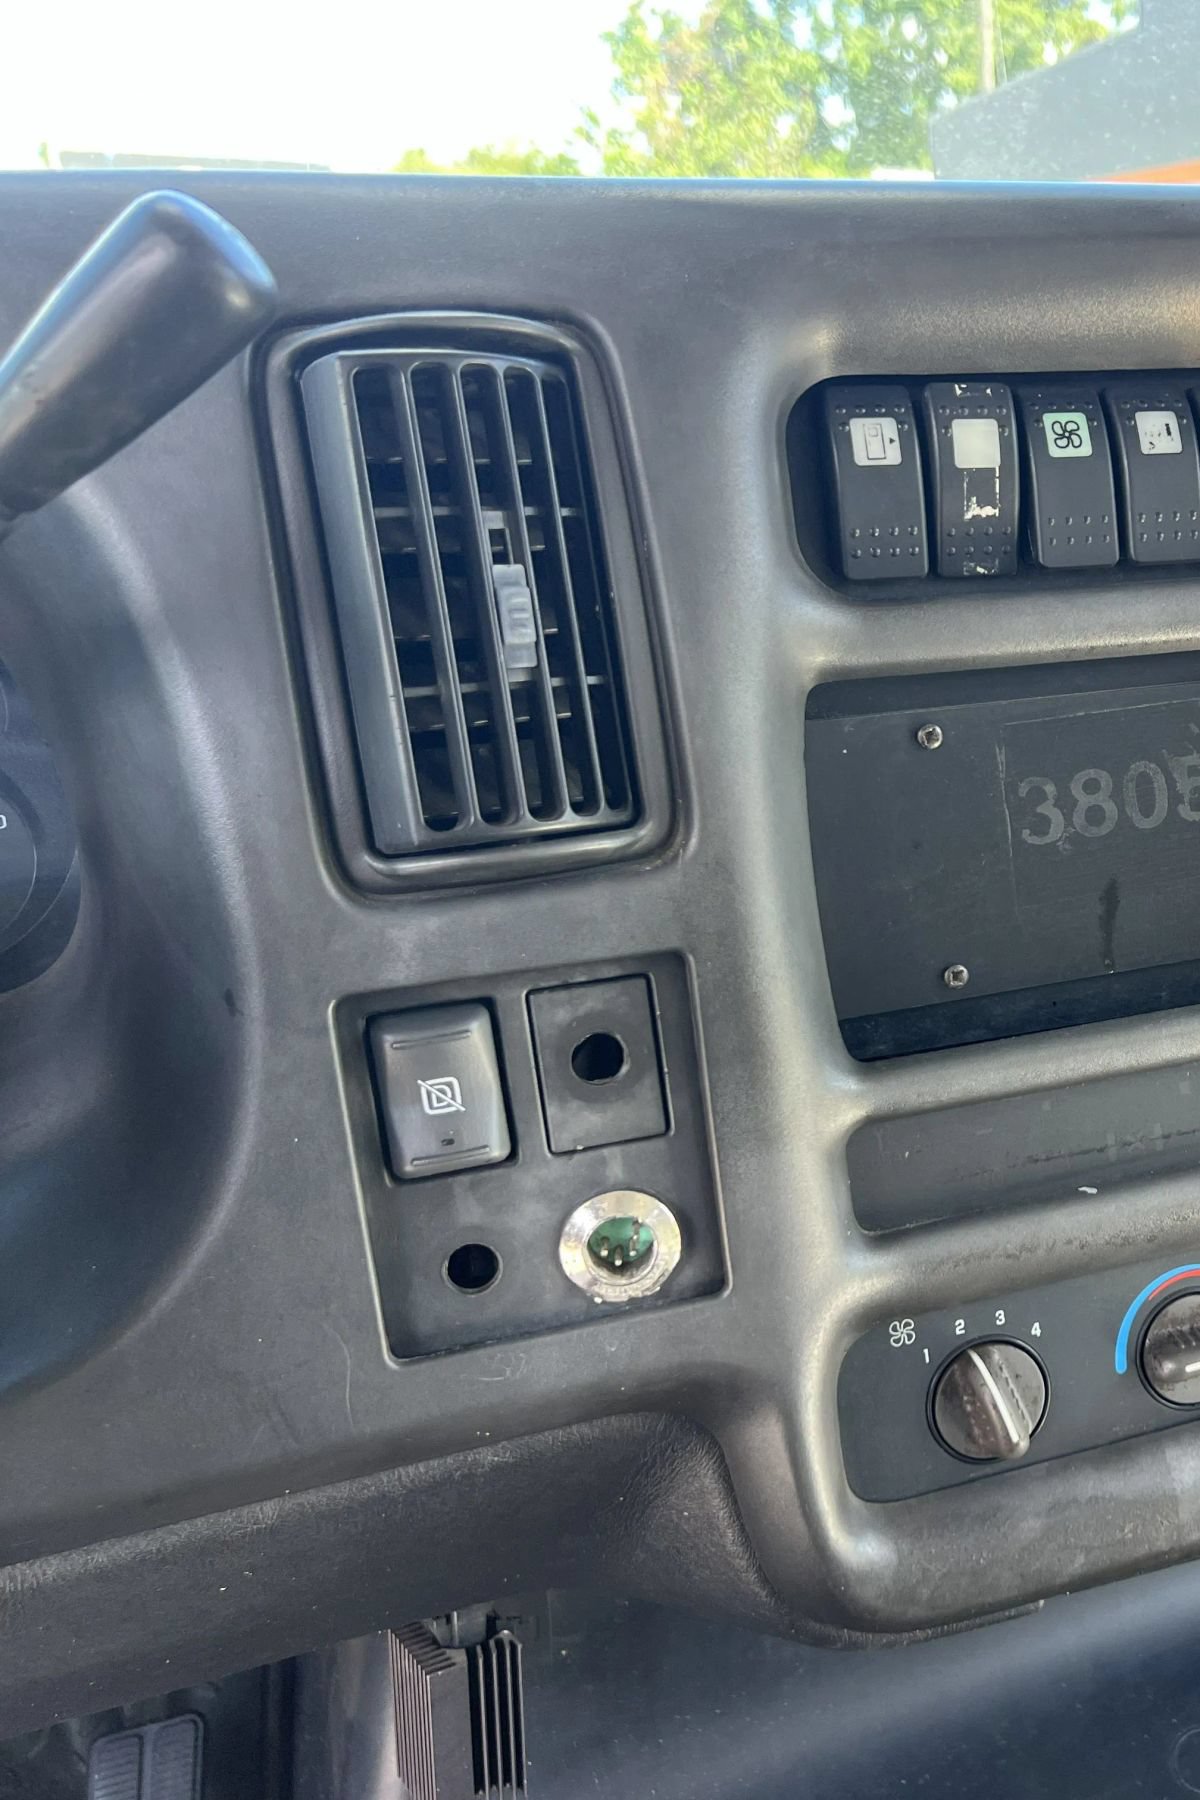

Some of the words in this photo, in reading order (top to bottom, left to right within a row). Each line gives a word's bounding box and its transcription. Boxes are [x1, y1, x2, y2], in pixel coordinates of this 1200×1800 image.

[923, 1348, 930, 1364] 1
[955, 1319, 965, 1335] 2
[995, 1309, 1006, 1325] 3
[1030, 1321, 1041, 1337] 4
